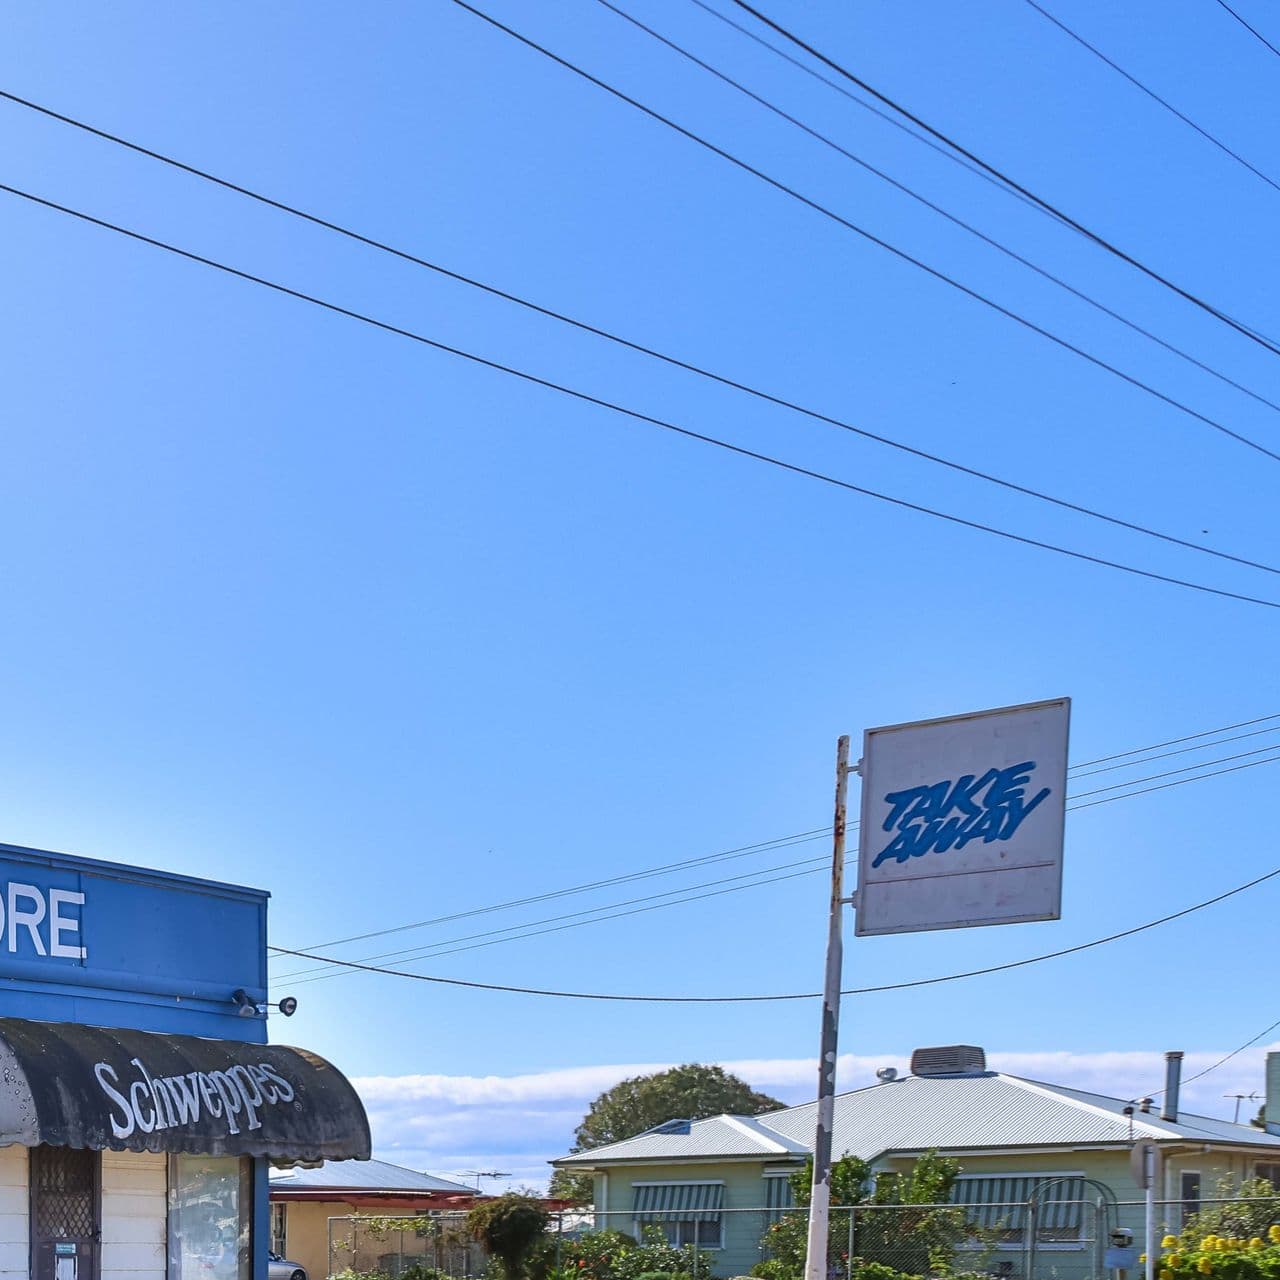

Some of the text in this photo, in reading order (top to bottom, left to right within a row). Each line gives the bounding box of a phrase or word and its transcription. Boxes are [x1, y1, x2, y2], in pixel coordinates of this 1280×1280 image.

[871, 787, 1052, 869] AWAY
[881, 761, 1037, 832] TAKE
[94, 1057, 295, 1140] Schweppes
